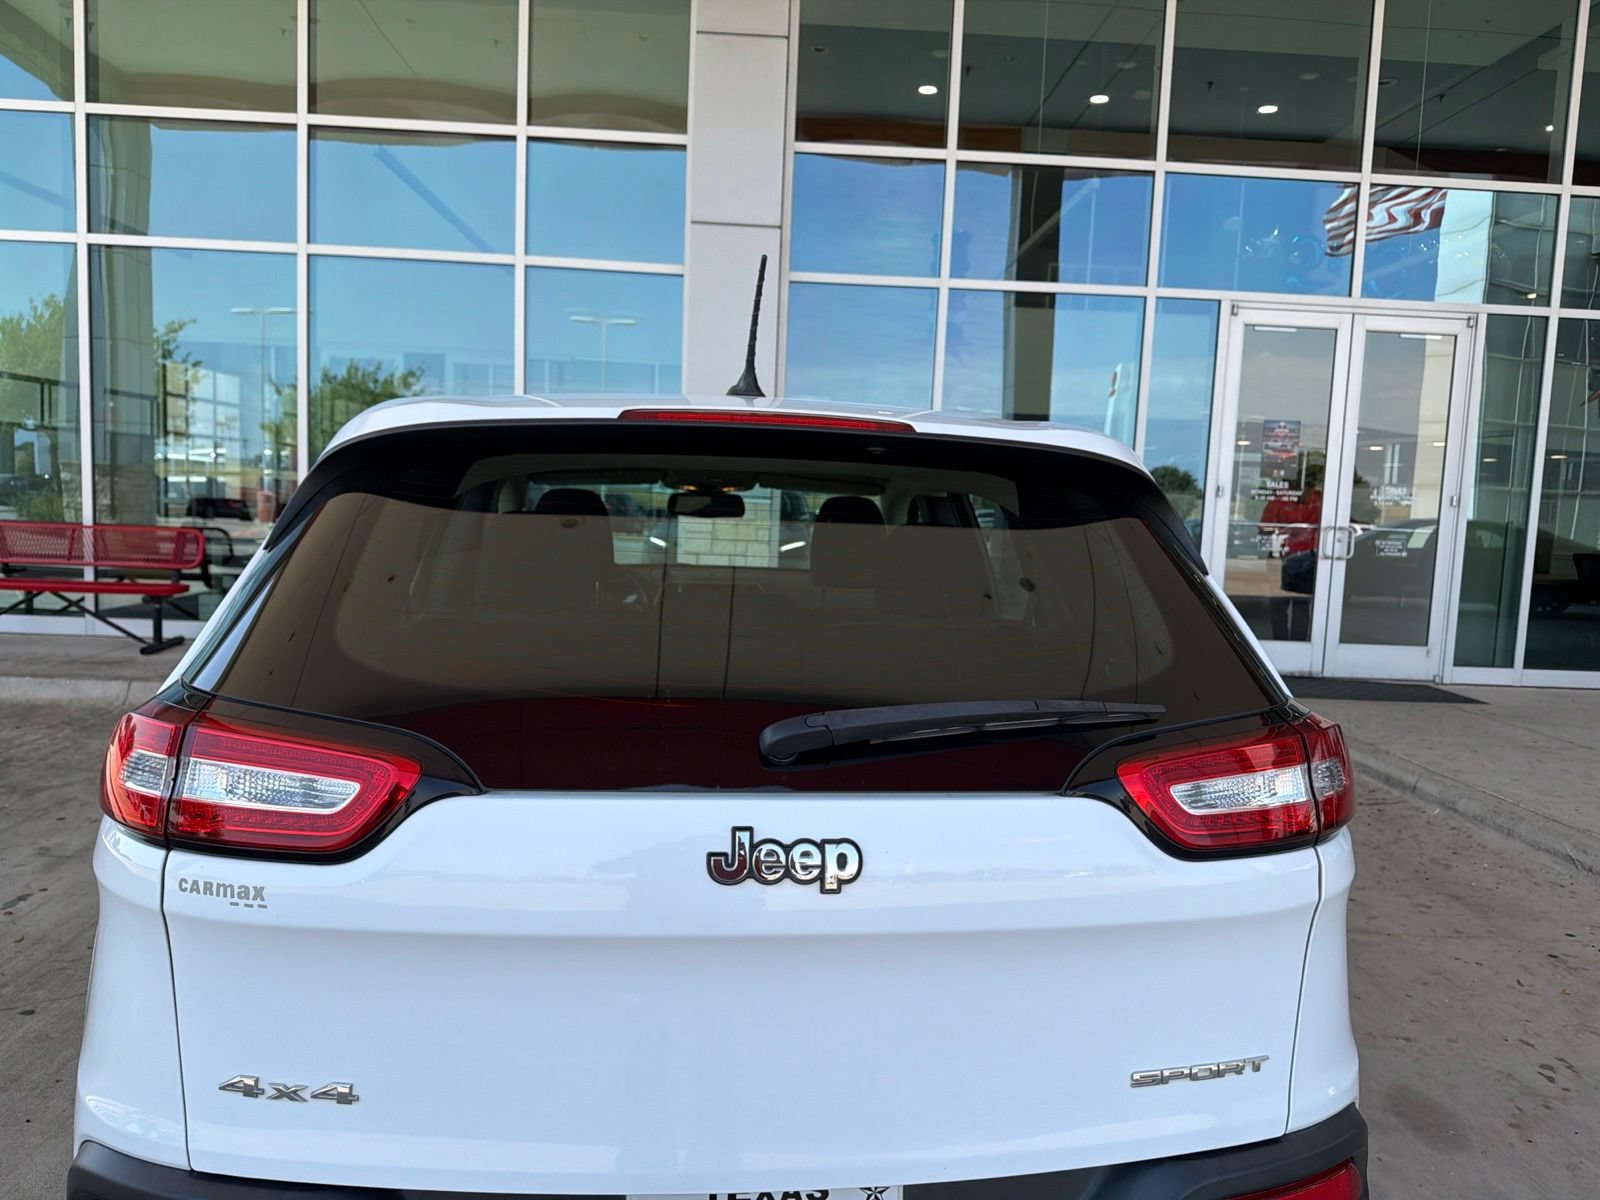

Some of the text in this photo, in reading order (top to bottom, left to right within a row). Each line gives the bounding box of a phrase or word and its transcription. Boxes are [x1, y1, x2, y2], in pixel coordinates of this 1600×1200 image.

[1266, 480, 1289, 488] SALES
[706, 826, 863, 894] Jeep
[1130, 1055, 1270, 1088] SPORT
[218, 1074, 359, 1105] 4x4
